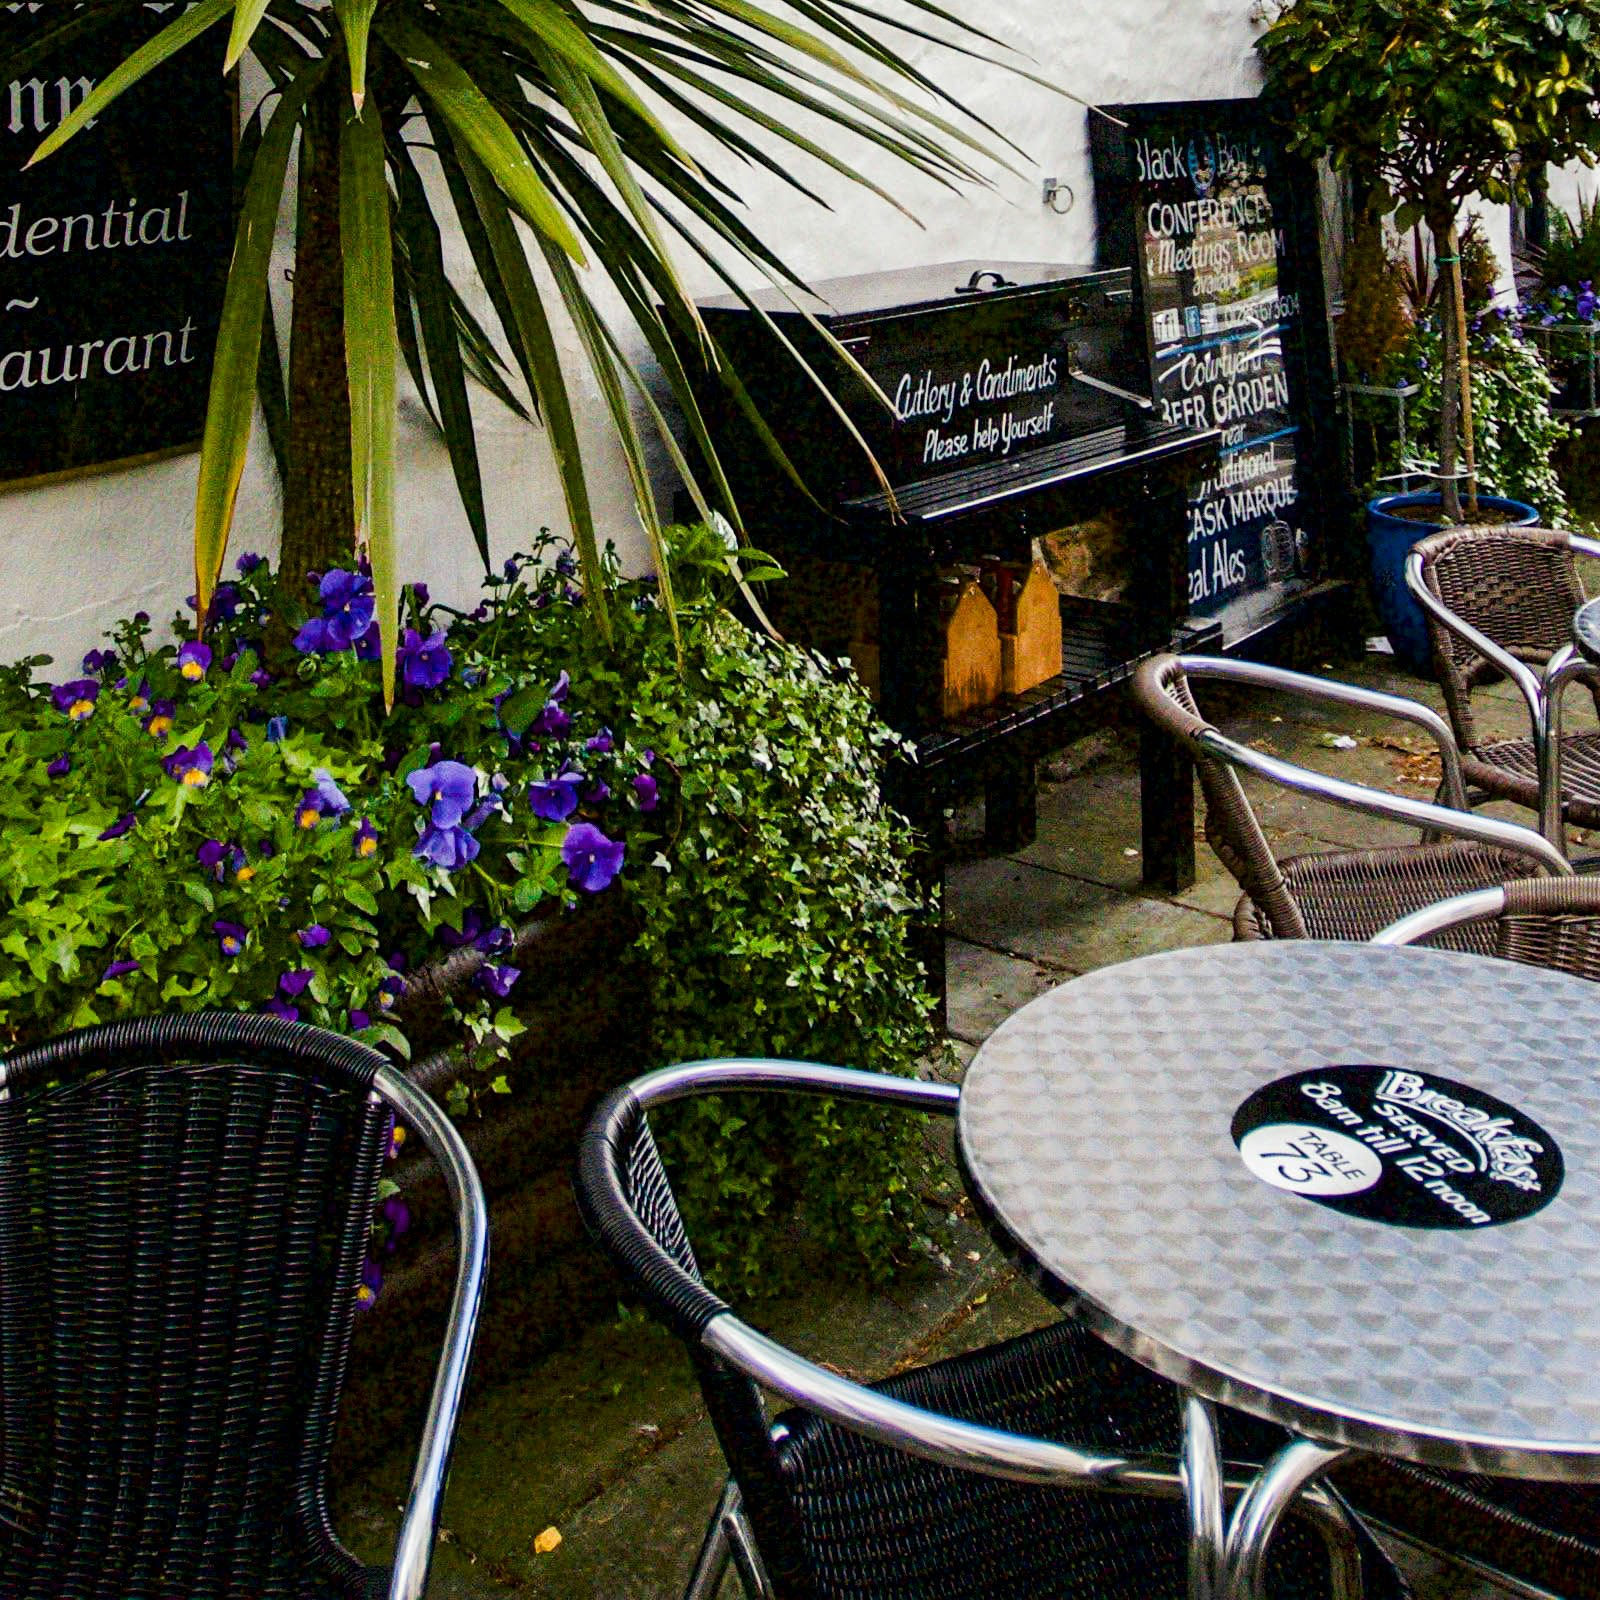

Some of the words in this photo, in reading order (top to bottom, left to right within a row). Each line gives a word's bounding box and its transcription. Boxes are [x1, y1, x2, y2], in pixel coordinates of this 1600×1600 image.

[1147, 193, 1267, 239] CONFERENCE
[1159, 238, 1232, 276] Meetings
[895, 369, 957, 423] Cutlery
[960, 372, 973, 407] &
[977, 353, 1057, 401] Condiments
[1212, 372, 1290, 423] GARDEN
[923, 428, 969, 464] Please
[973, 417, 1000, 453] help
[1002, 401, 1054, 455] Yourself
[1198, 442, 1278, 503] aditional
[1230, 475, 1297, 526] MARQUE
[1213, 538, 1247, 595] Ales
[1297, 1130, 1368, 1181] TABLE
[1300, 1081, 1363, 1128] 8am
[1356, 1123, 1413, 1155] till
[1395, 1154, 1445, 1182] 12
[1422, 1178, 1492, 1225] noon
[1373, 1102, 1476, 1175] SERVED
[1377, 1069, 1544, 1193] Breakfast
[1260, 1141, 1334, 1184] 73
